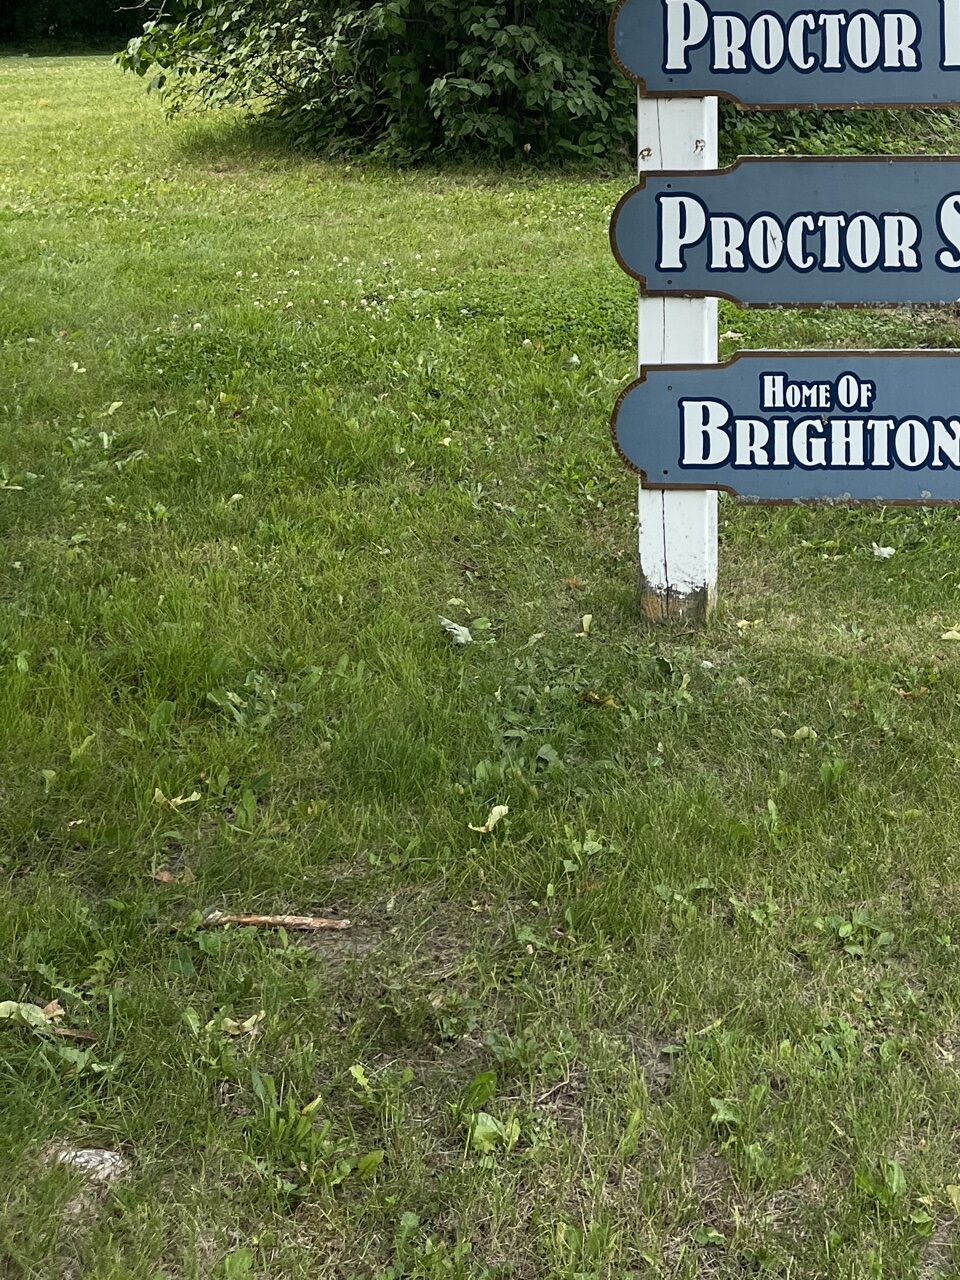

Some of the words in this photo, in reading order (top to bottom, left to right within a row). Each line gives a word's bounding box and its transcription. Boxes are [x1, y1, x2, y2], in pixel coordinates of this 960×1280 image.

[658, 195, 919, 270] PROCTOR
[762, 375, 831, 409] HOME
[836, 375, 873, 410] OF
